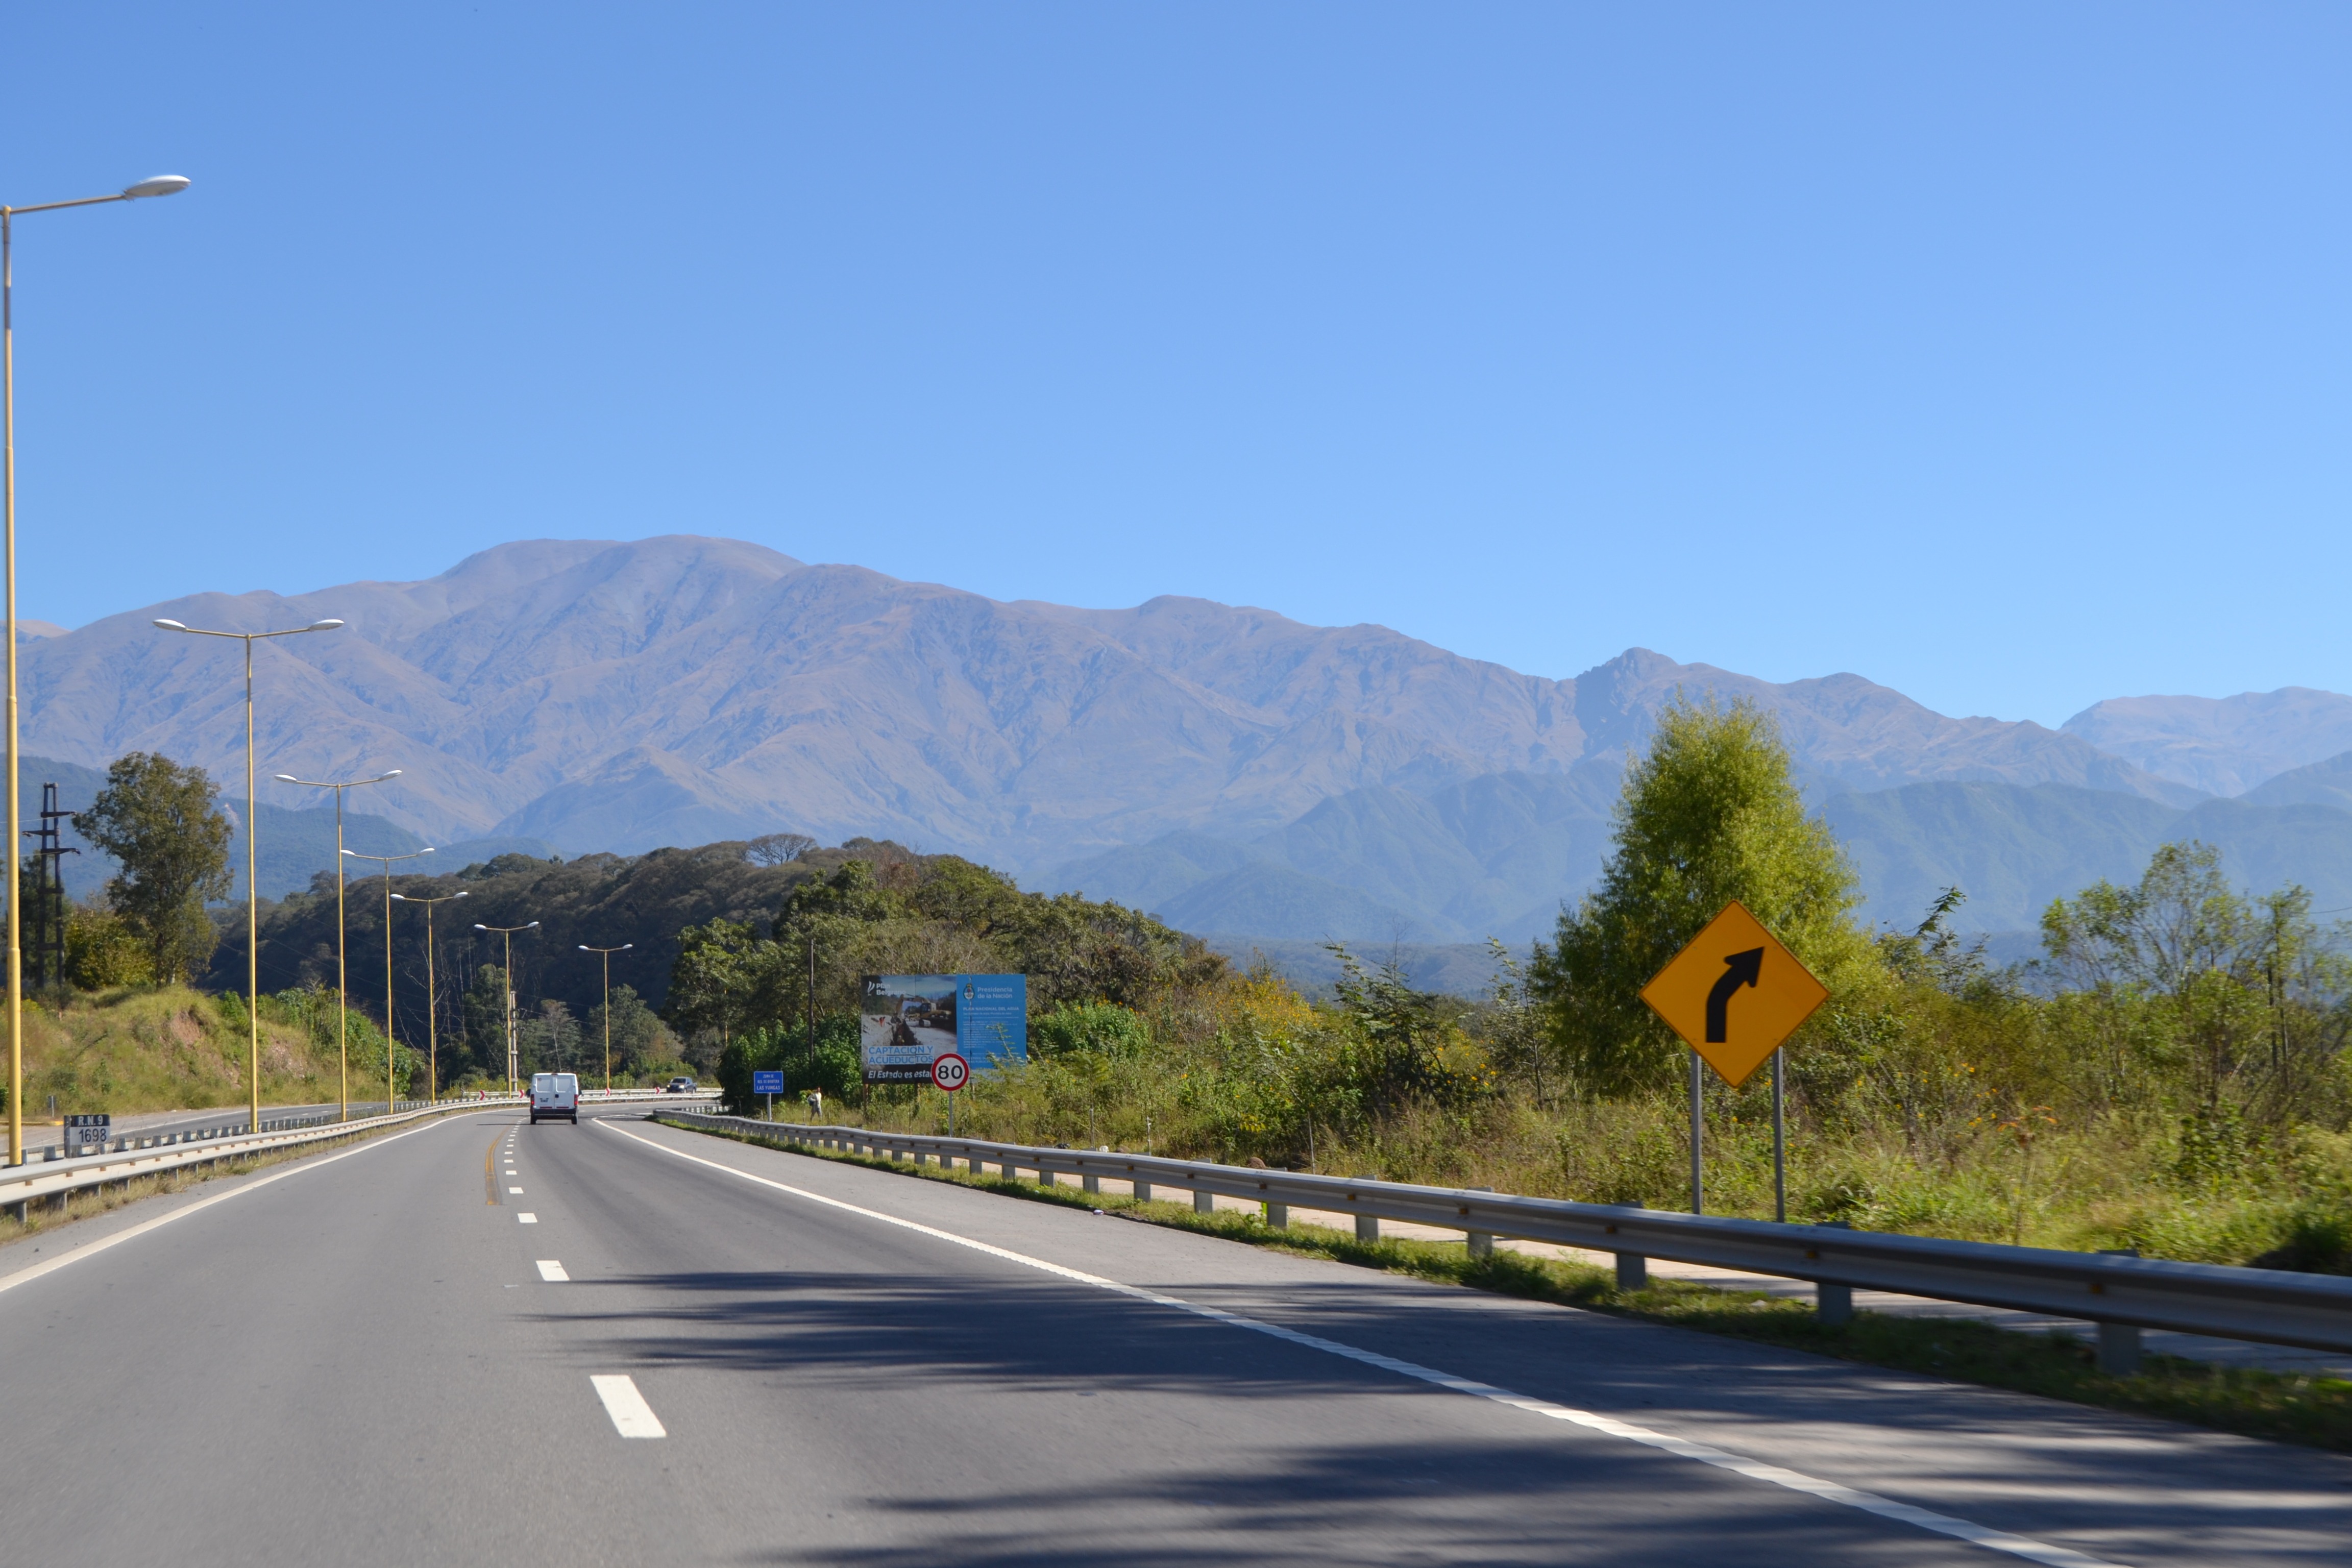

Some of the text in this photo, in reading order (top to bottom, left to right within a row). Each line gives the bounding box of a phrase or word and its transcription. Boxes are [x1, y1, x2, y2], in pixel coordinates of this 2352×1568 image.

[869, 1055, 934, 1064] ACUEDUCTOS
[938, 1065, 963, 1080] 80
[78, 1115, 103, 1125] R.N. 9
[79, 1128, 107, 1142] 1698
